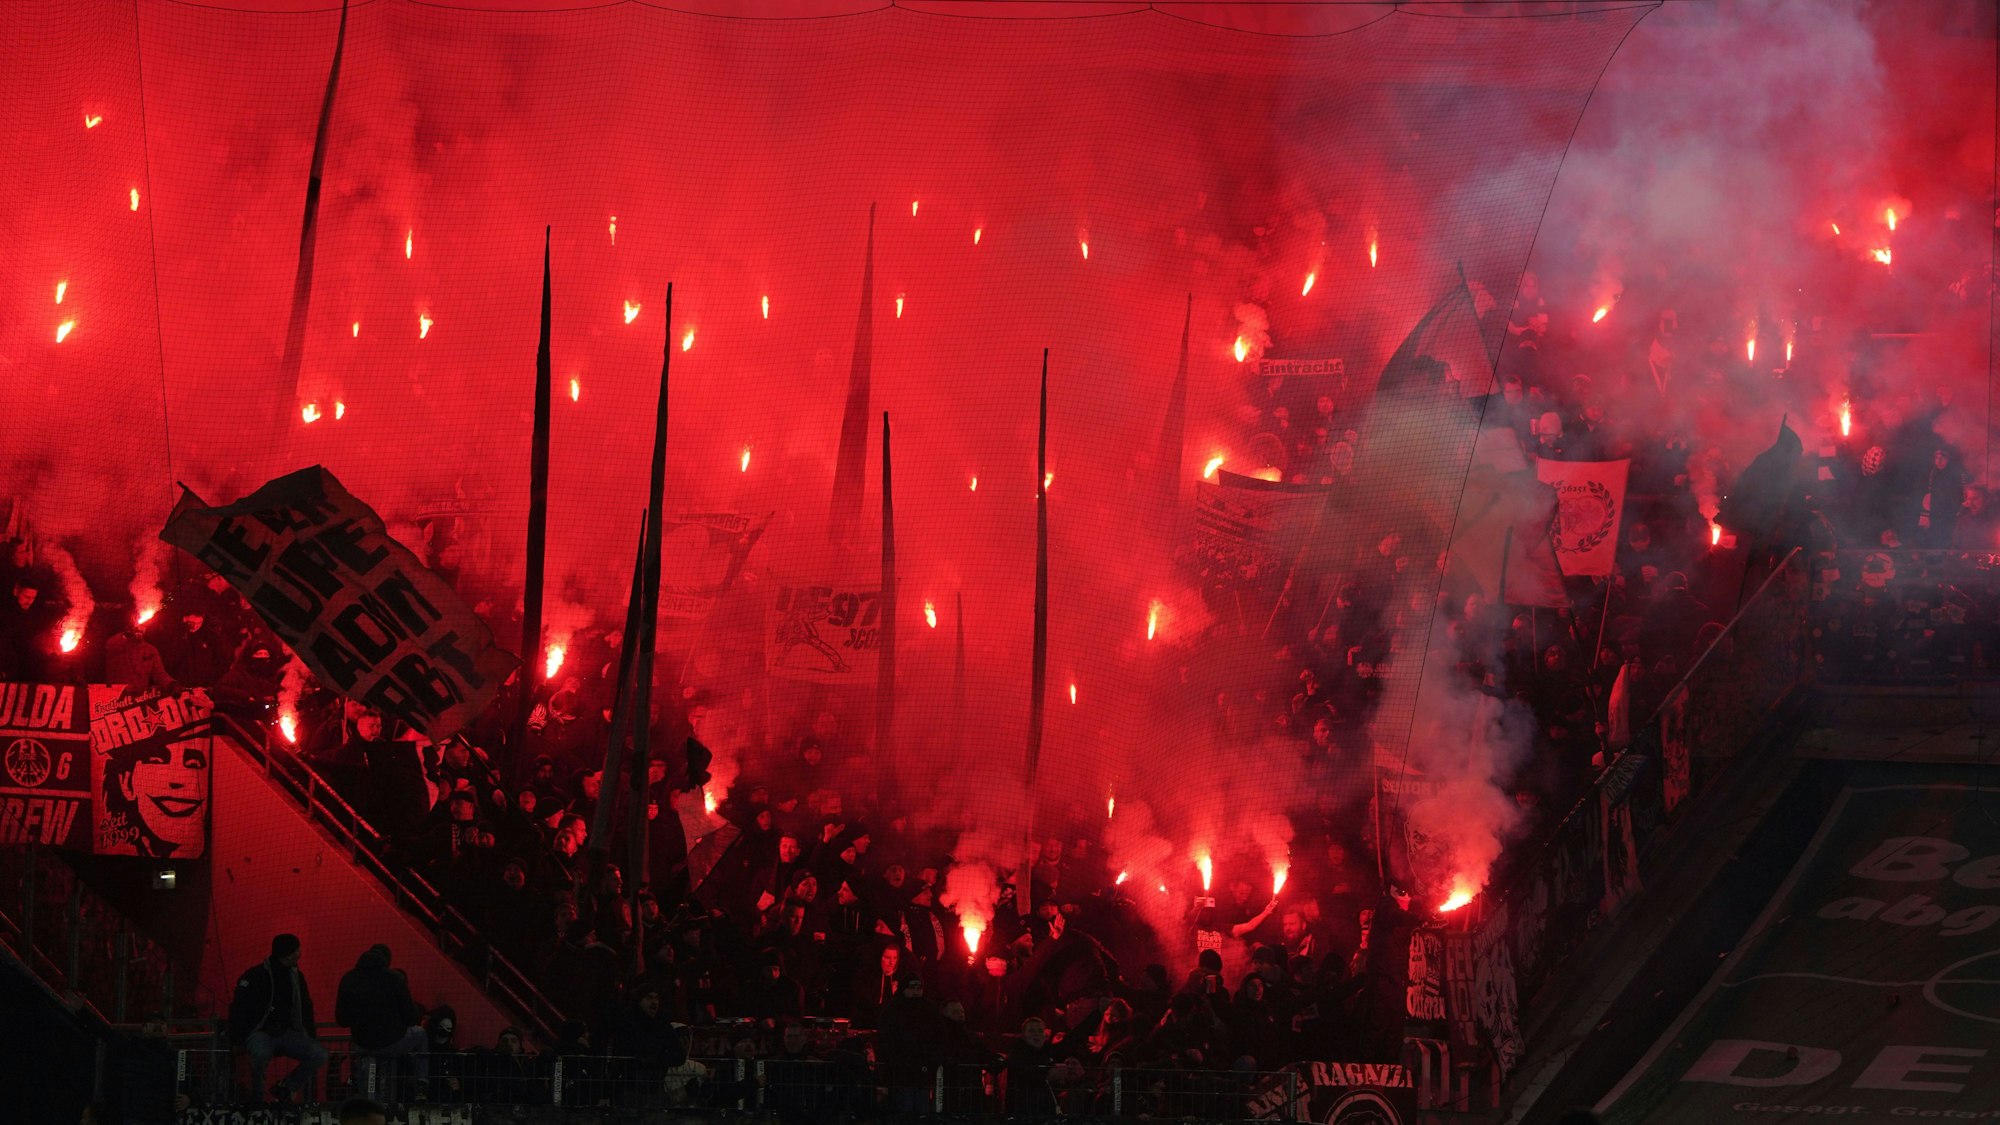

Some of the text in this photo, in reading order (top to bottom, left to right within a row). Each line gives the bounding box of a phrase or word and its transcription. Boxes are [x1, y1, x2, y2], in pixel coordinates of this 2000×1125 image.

[1260, 360, 1342, 375] Eintracht
[0, 799, 80, 847] REW
[99, 826, 140, 849] 1999
[1311, 1060, 1415, 1089] RAGAZZI
